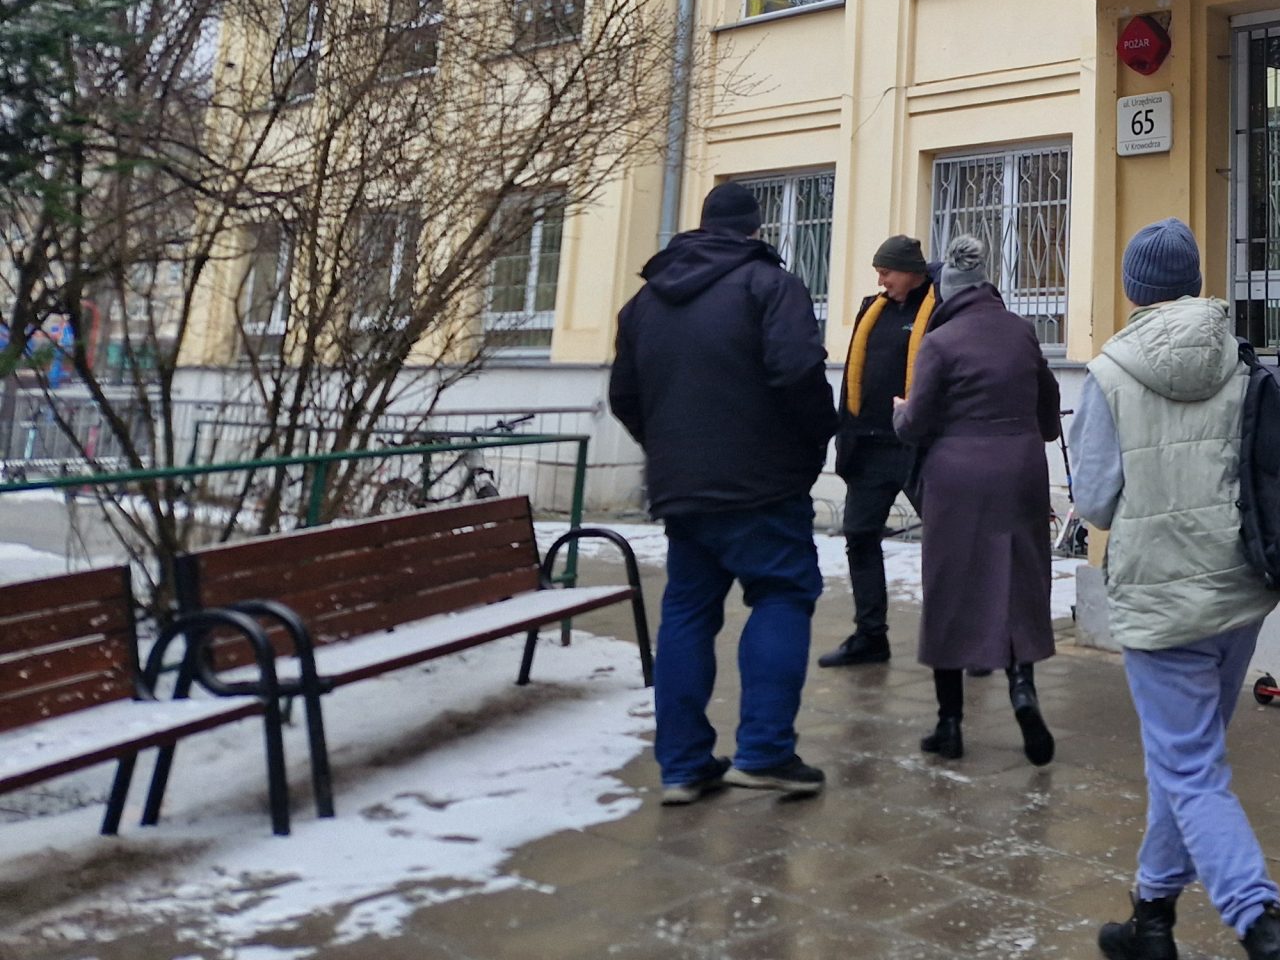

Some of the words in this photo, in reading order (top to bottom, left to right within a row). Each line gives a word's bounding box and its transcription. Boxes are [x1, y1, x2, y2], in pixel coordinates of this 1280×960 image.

[1124, 38, 1149, 50] POŻAR
[1131, 96, 1162, 107] Urzędnicza
[1131, 109, 1154, 135] 65
[1131, 141, 1161, 149] Krowodrza
